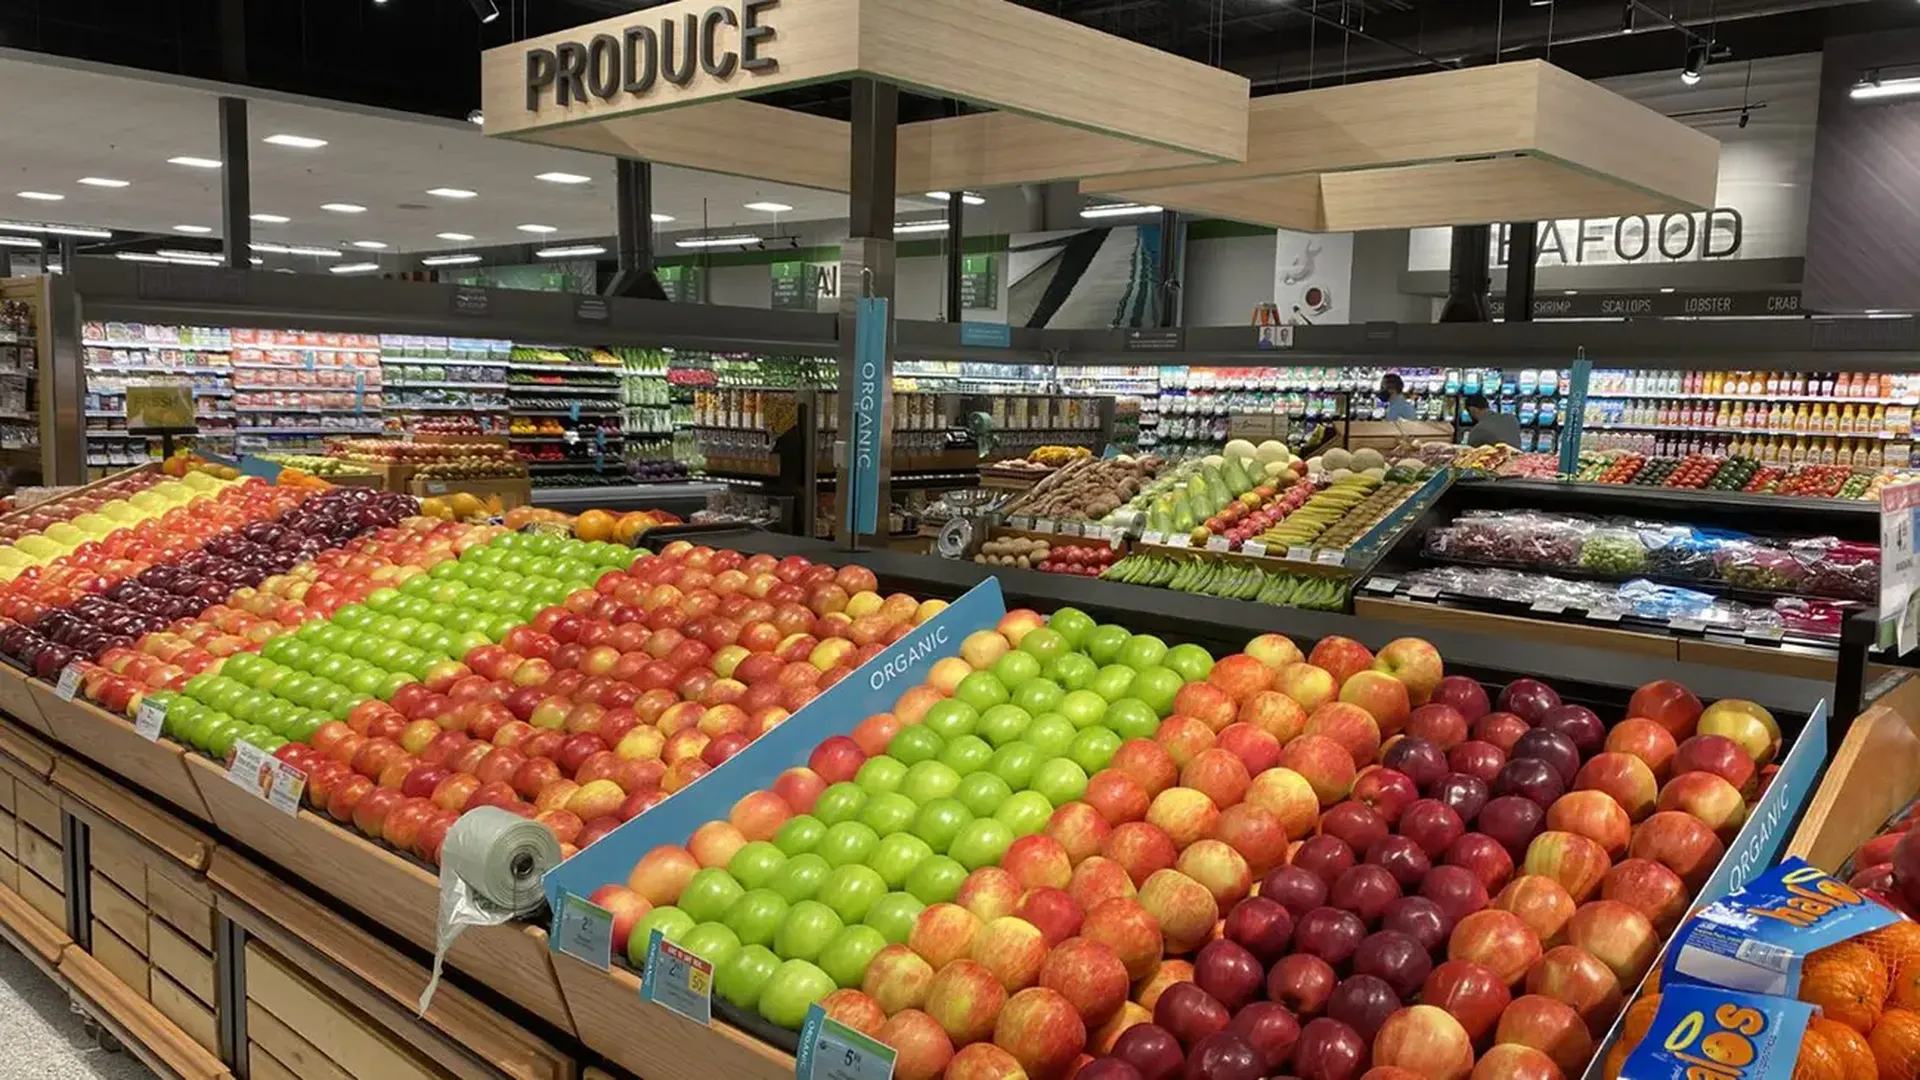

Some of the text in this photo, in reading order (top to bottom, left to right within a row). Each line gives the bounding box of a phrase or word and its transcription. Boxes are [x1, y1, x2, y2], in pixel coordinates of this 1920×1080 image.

[526, 0, 780, 112] PRODUCE
[1533, 301, 1571, 314] SHRIMP
[1602, 299, 1651, 313] SCALLOPS
[1685, 297, 1731, 312] LOBSTER
[1767, 296, 1798, 310] CRAB
[860, 362, 875, 468] ORGANIC
[870, 625, 949, 690] ORGANIC
[1729, 783, 1789, 892] ORGANIC
